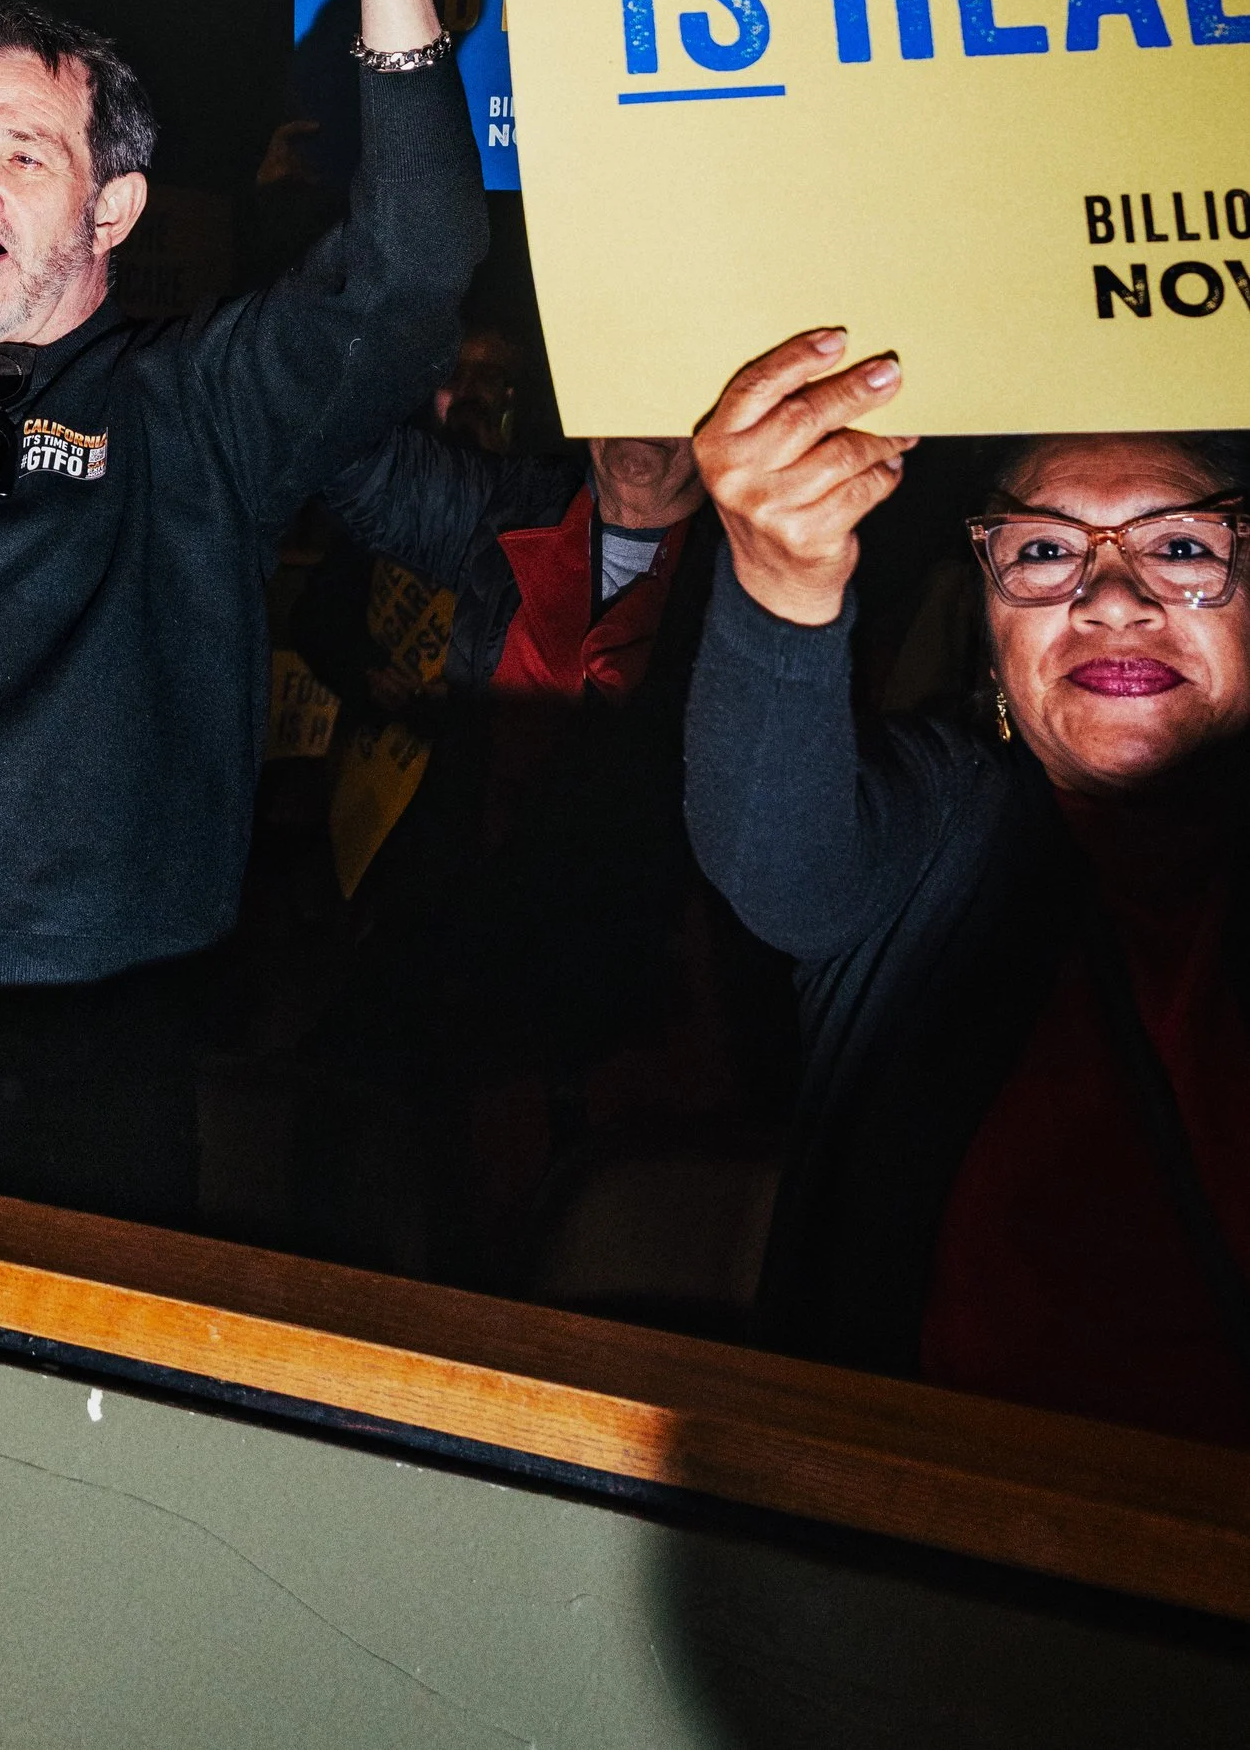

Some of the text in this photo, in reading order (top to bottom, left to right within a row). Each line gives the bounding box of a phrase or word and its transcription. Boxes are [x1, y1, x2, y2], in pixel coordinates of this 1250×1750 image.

[488, 123, 517, 147] N
[1084, 188, 1250, 244] BILLIO
[22, 433, 84, 457] IT'S TIME TO
[20, 445, 83, 478] #GTFO
